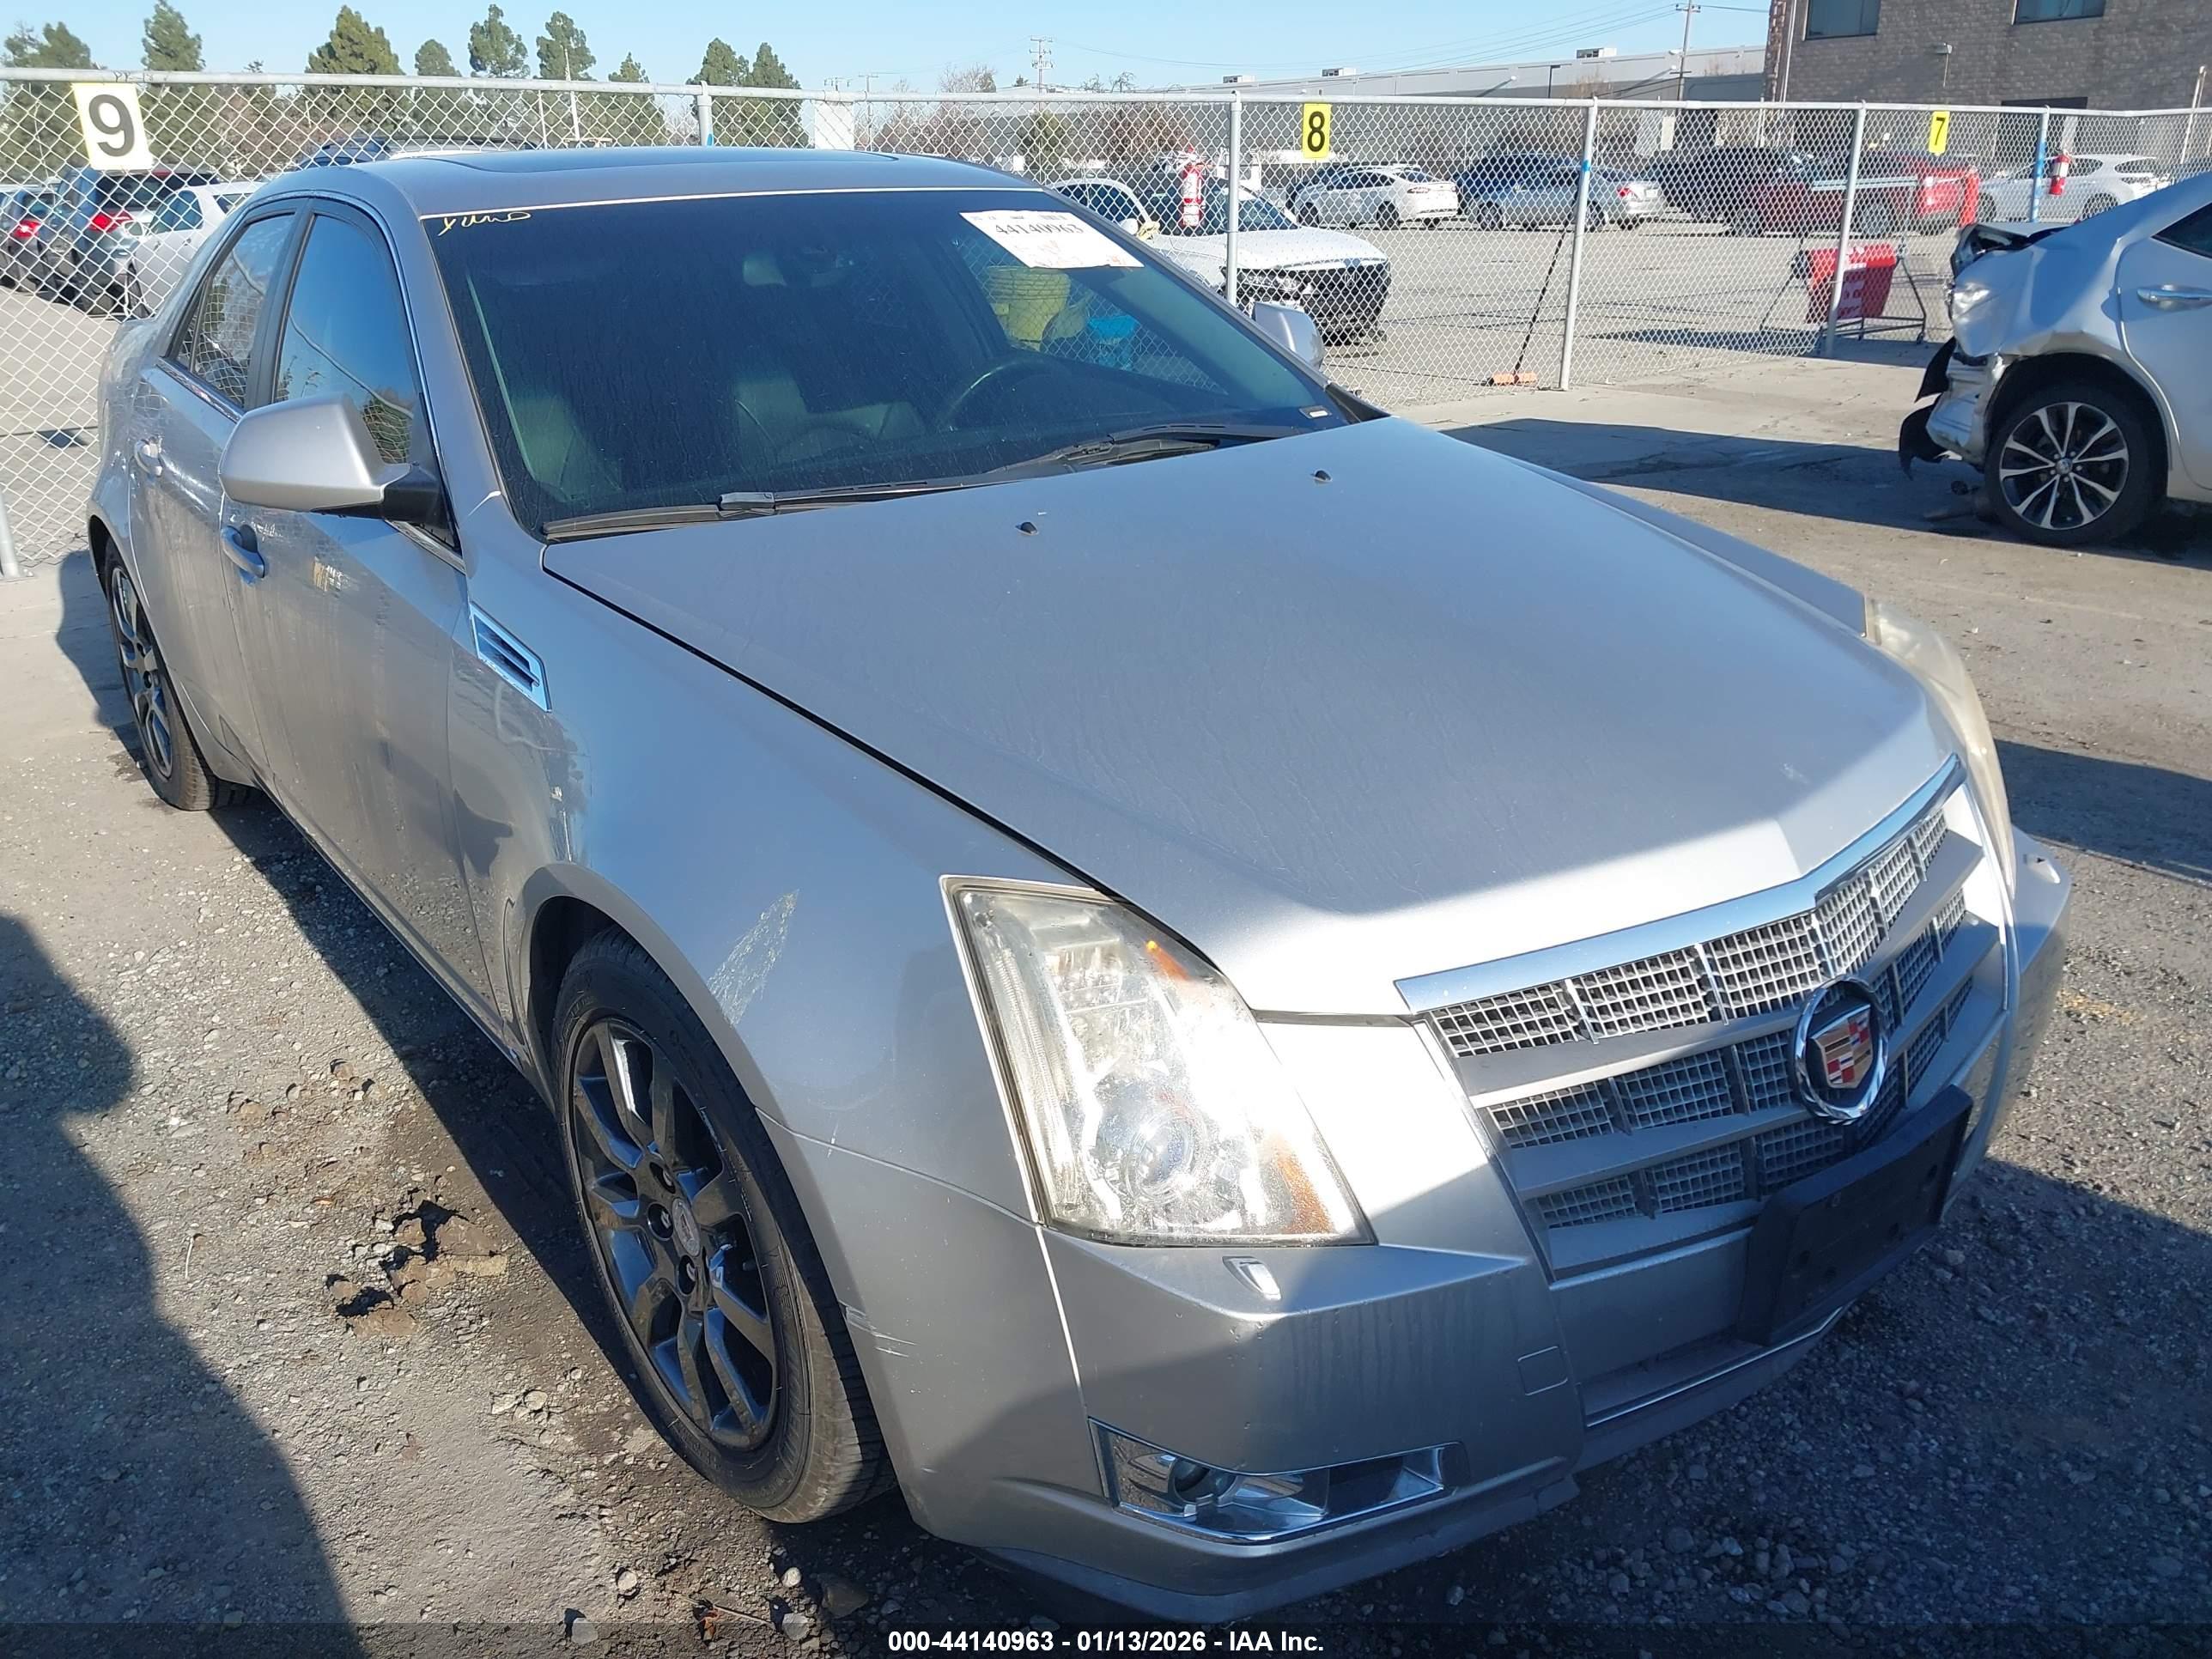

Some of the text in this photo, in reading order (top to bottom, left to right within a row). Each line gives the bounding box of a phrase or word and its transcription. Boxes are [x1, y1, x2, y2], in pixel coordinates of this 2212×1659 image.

[88, 94, 135, 157] 9
[1307, 111, 1325, 152] 8
[1934, 117, 1946, 146] 7
[995, 224, 1084, 234] 44140963
